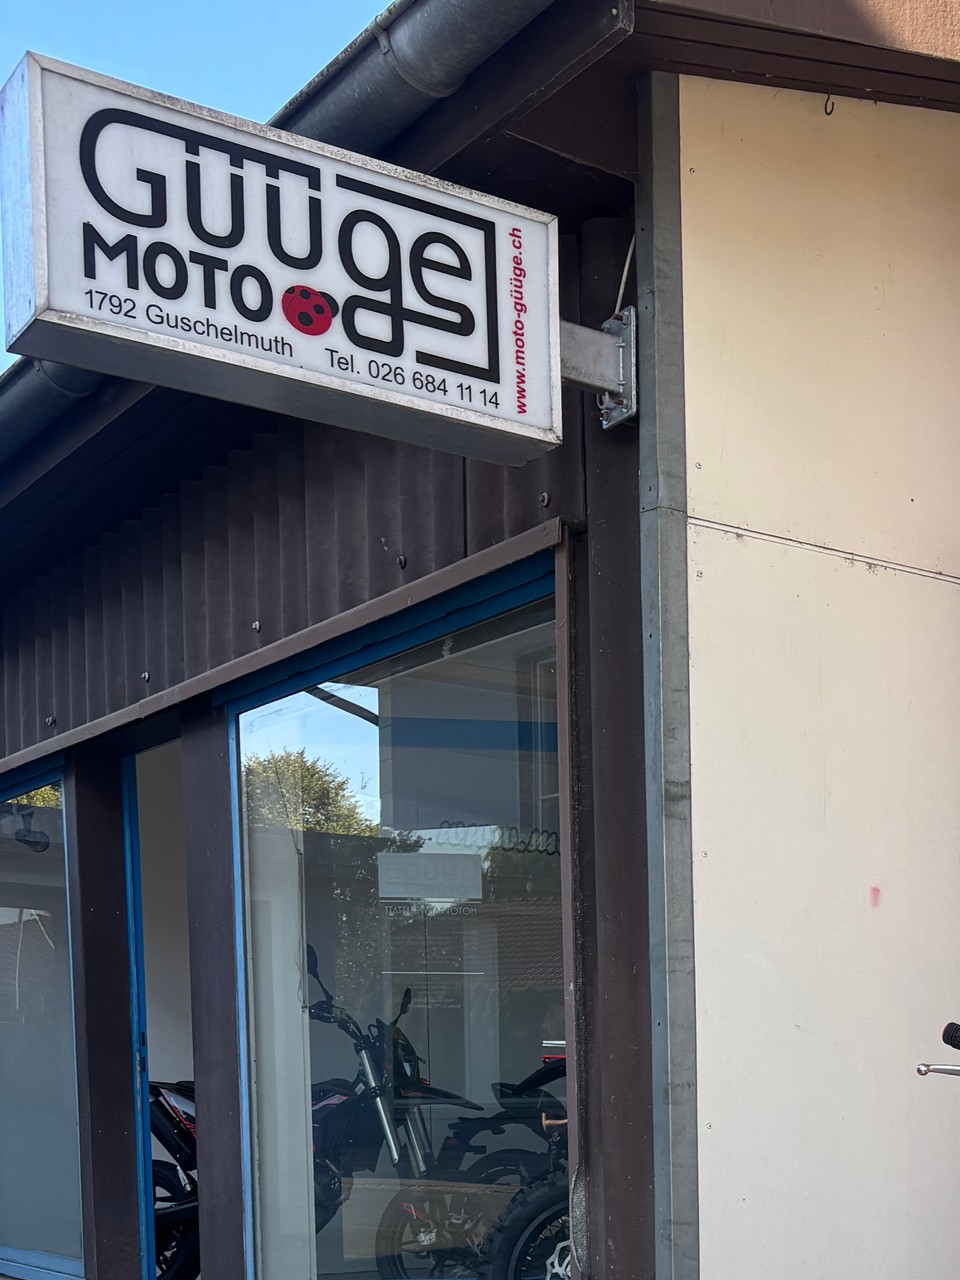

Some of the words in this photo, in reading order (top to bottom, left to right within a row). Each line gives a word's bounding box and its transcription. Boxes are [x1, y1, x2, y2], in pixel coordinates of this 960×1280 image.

[83, 221, 273, 322] MOTO
[84, 288, 137, 319] 1792
[145, 303, 294, 358] Guschelmuth
[508, 226, 528, 416] www.moto-güüge.ch
[324, 347, 361, 375] Tel.
[368, 359, 406, 386] 026
[412, 371, 449, 397] 684
[456, 382, 472, 403] 11
[479, 388, 500, 410] 14
